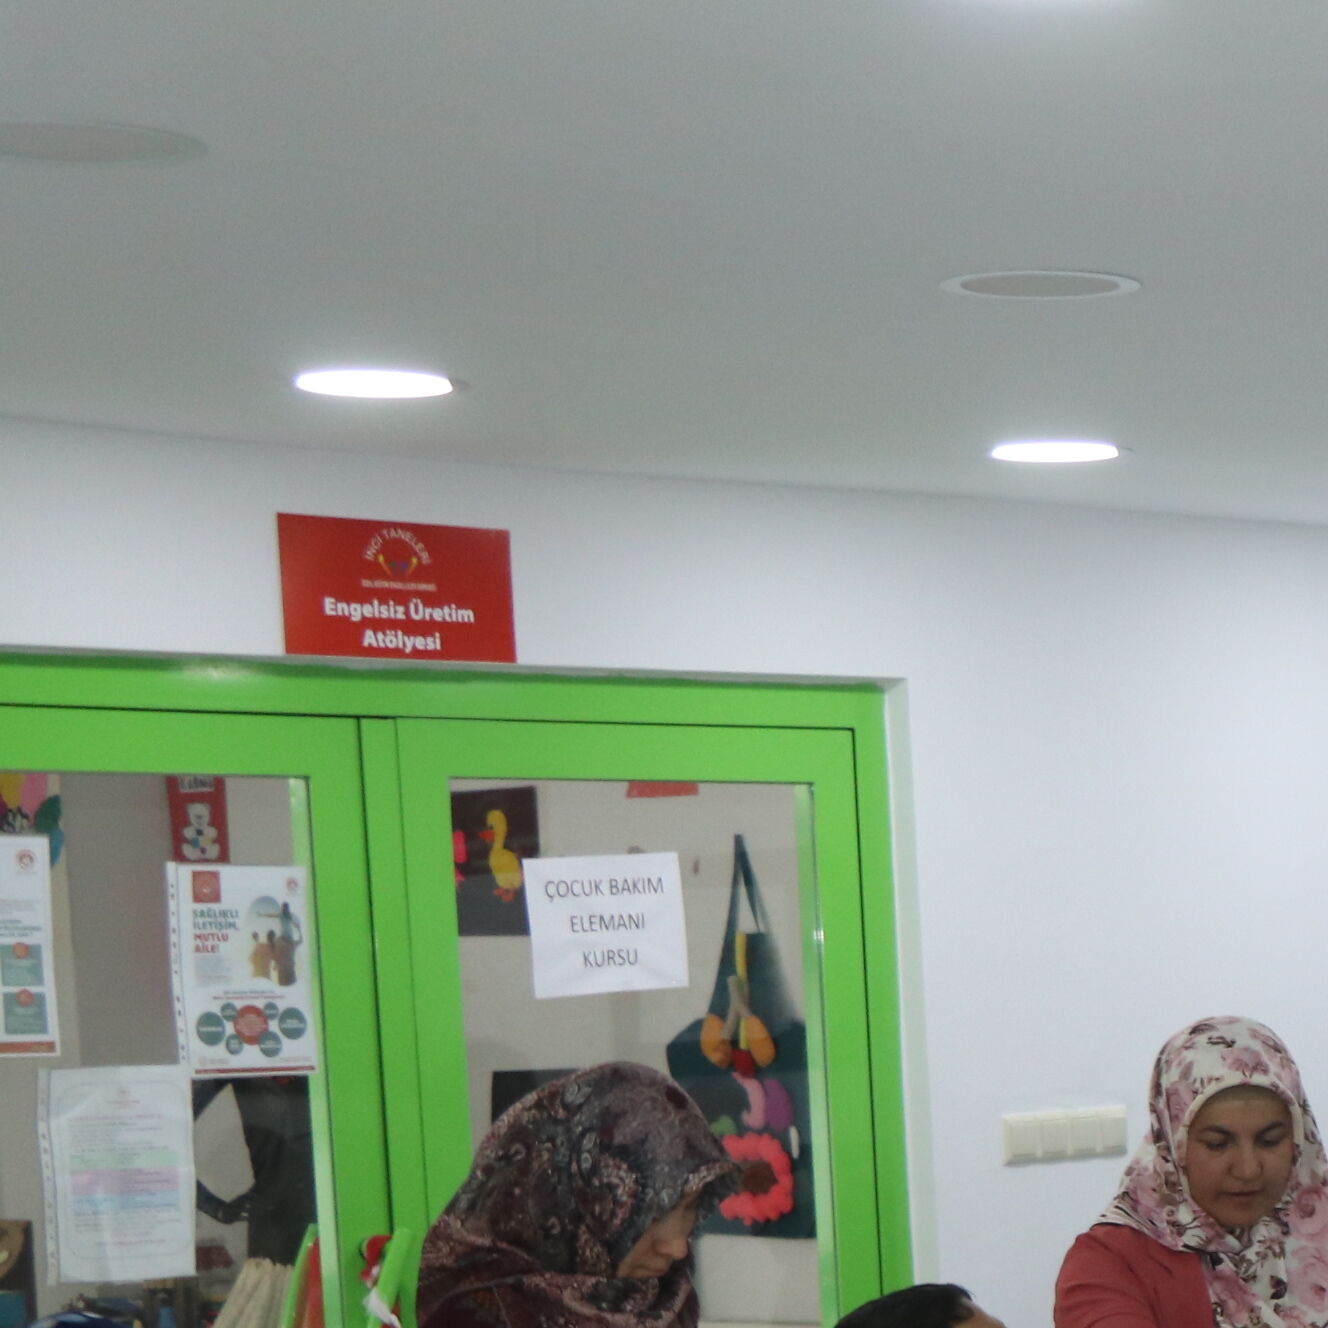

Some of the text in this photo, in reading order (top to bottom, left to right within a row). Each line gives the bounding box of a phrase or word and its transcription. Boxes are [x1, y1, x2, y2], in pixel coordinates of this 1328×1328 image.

[324, 597, 475, 622] Engelsiz Üretim
[362, 629, 442, 653] Atölyesi
[544, 877, 664, 902] ÇOCUK BAKIM
[570, 913, 646, 933] ELEMANI
[583, 948, 639, 968] KURSU
